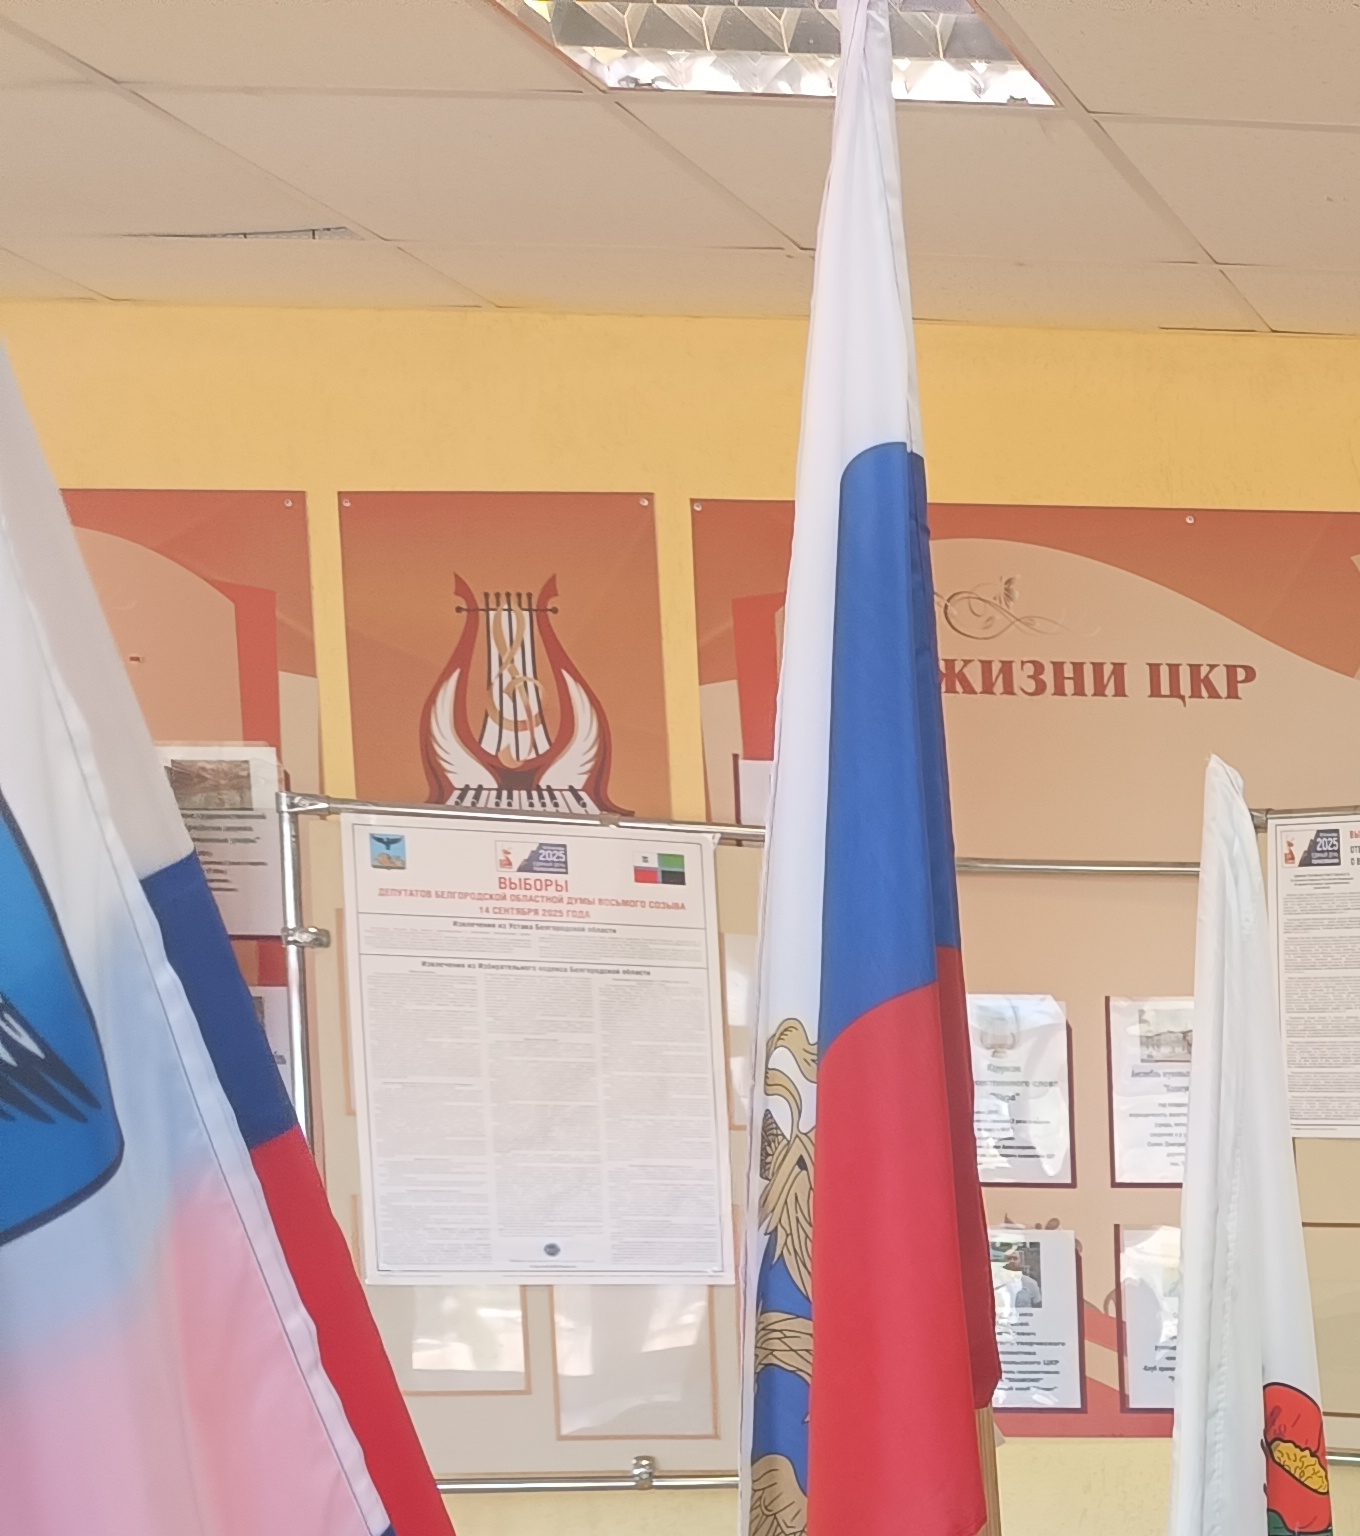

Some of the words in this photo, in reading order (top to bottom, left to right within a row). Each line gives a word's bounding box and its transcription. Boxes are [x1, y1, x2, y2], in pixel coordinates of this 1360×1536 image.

[938, 657, 1129, 698] ЖИЗНИ
[1144, 661, 1257, 708] ЦКР
[1316, 837, 1340, 851] 2025
[538, 849, 566, 862] 2025
[1350, 857, 1356, 866] О
[497, 876, 569, 893] ВЫБОРЫ
[378, 887, 432, 899] ДЕПУТАТОВ
[434, 890, 507, 902] БЕЛГОРОДСКОЙ
[509, 893, 564, 905] ОБЛАСТНОЙ
[566, 895, 596, 906] ДУМЫ
[597, 897, 647, 909] ВОСЬМОГО
[648, 900, 687, 911] СОЗЫВА
[479, 906, 490, 914] 14
[492, 906, 539, 916] СЕНТЯБРЯ
[541, 908, 564, 918] 2025
[566, 909, 591, 919] ГОДА
